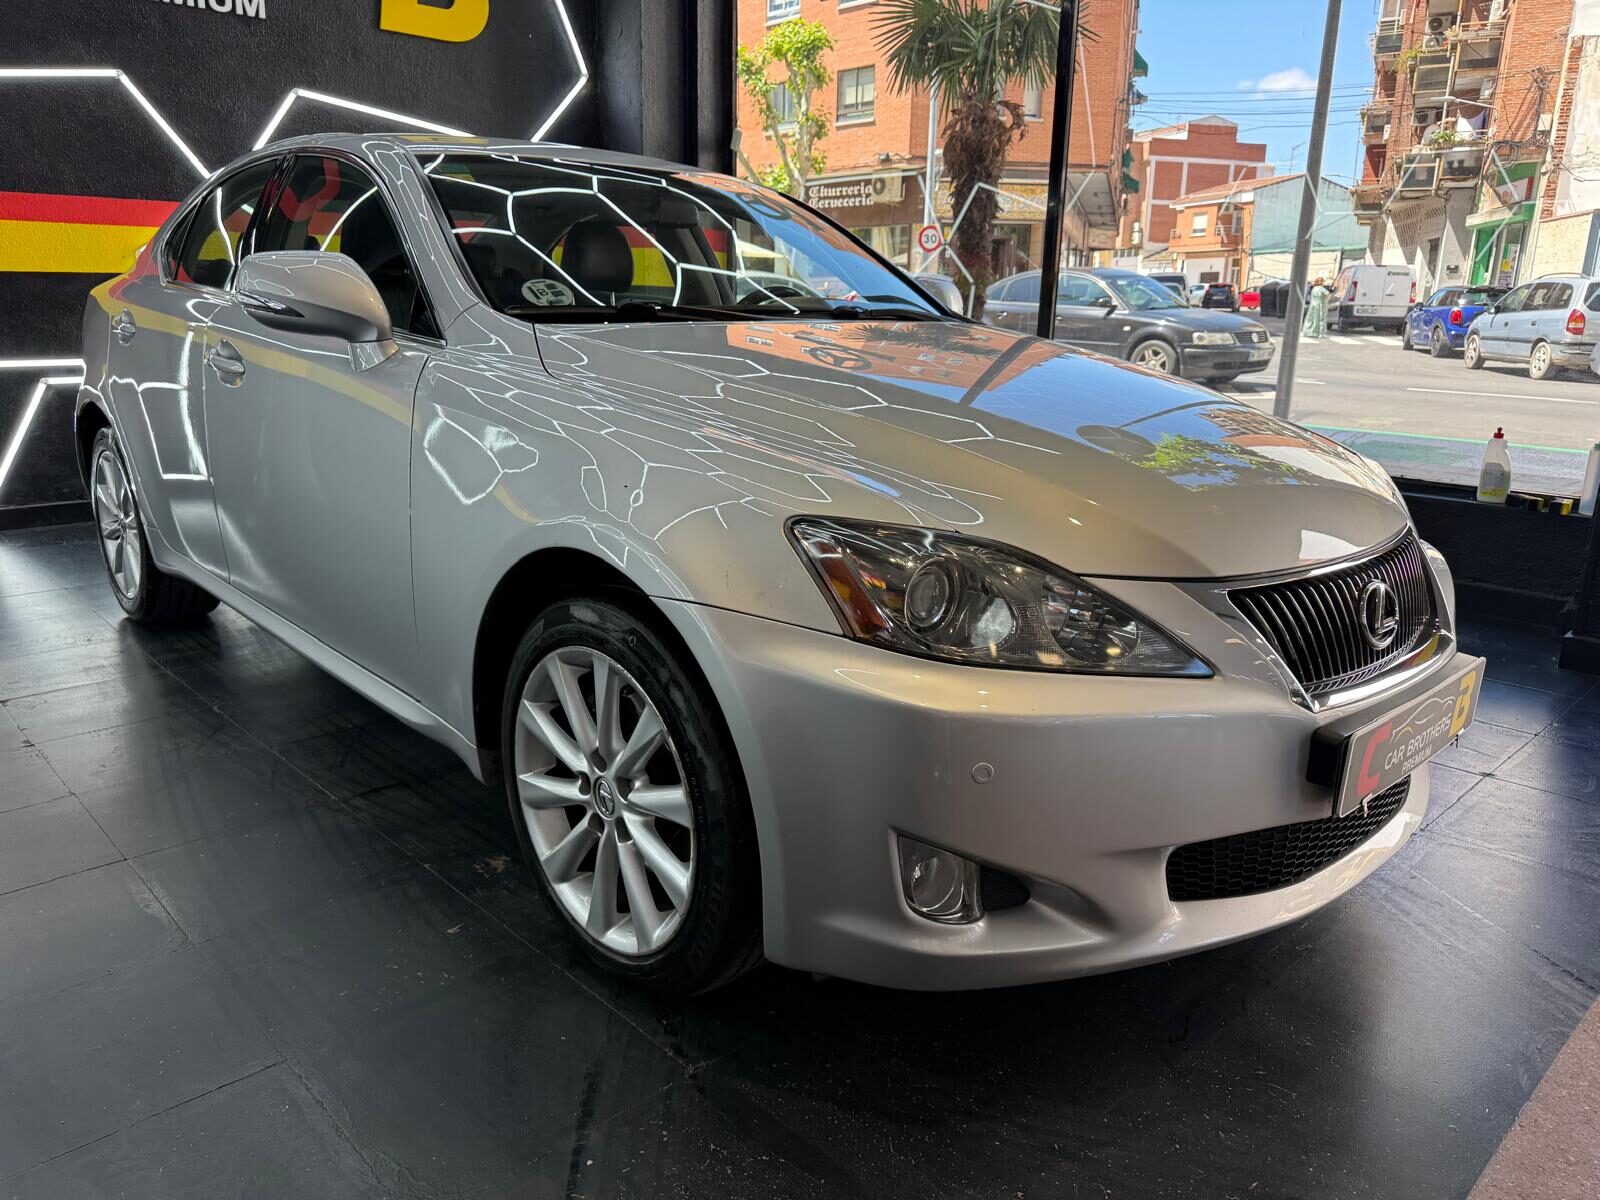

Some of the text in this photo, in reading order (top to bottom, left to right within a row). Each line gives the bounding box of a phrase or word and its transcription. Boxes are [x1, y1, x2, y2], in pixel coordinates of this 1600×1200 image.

[923, 233, 938, 244] 30
[1384, 712, 1452, 770] CAR BROTHERS
[1401, 744, 1433, 775] PREMIUM
